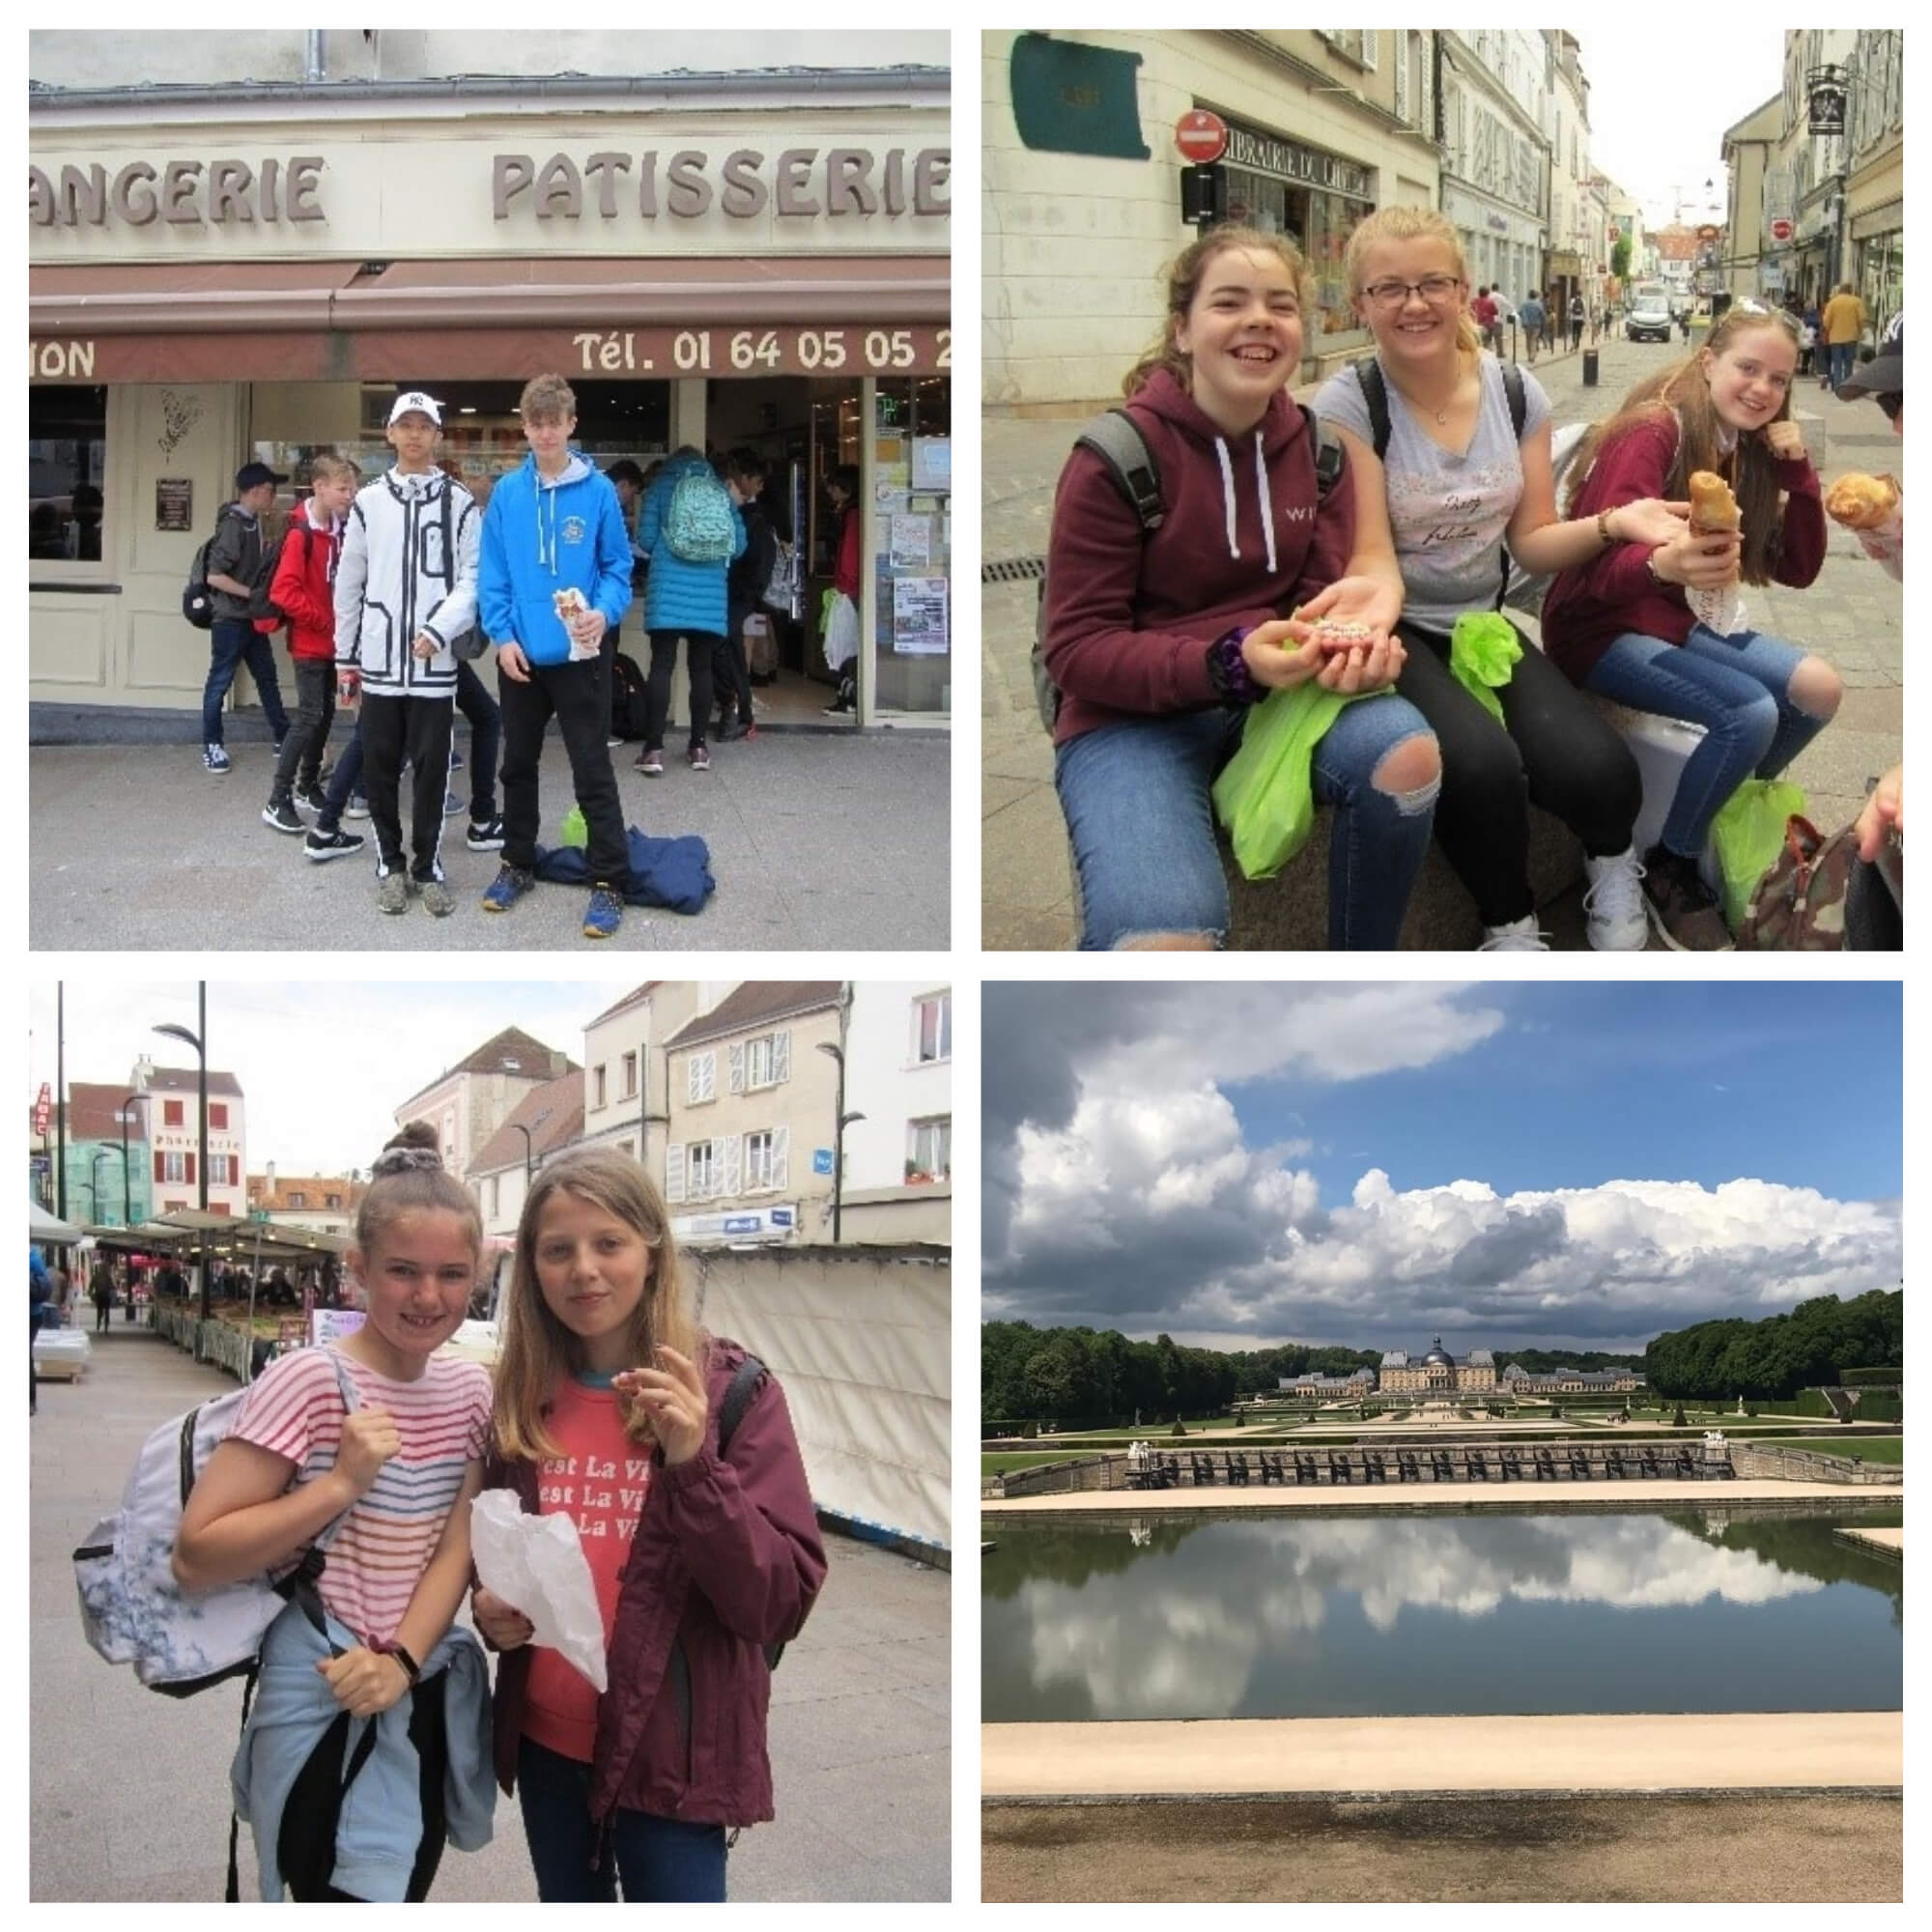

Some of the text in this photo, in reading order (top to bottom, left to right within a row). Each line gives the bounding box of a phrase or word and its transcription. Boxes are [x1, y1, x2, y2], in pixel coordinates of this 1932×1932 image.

[493, 148, 952, 220] PATISSERIE
[574, 329, 654, 370] Tél.
[673, 330, 712, 370] 01
[730, 330, 781, 370] 64
[798, 330, 847, 369] 05
[865, 329, 916, 369] 05
[585, 1456, 616, 1480] La
[582, 1485, 611, 1508] La
[579, 1513, 607, 1537] La
